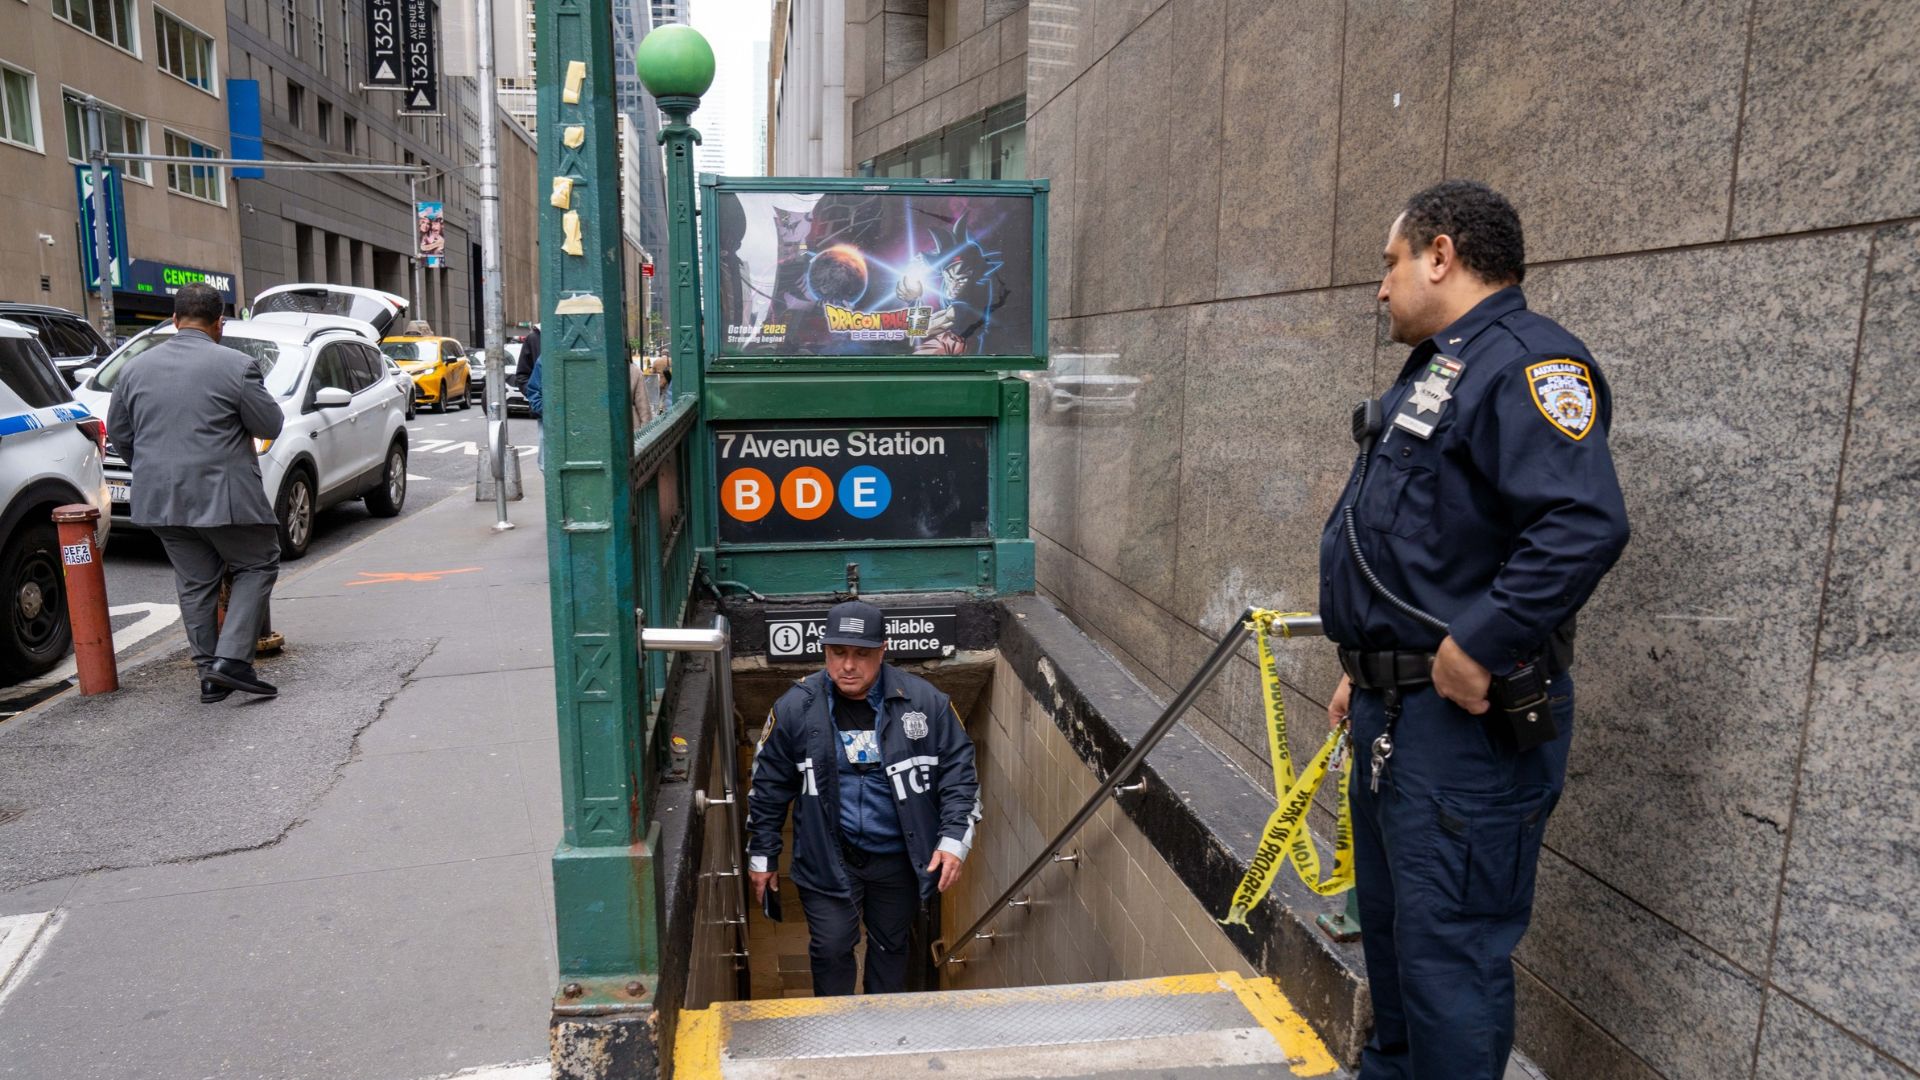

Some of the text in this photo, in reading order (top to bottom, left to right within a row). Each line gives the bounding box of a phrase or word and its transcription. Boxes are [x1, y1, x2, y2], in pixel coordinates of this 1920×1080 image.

[409, 4, 417, 40] AVENUE
[374, 8, 394, 57] 1325
[418, 23, 426, 39] THE
[410, 42, 428, 86] 1325
[825, 304, 880, 331] DRAGON
[763, 324, 787, 335] 2026
[852, 331, 904, 340] BEERUS
[761, 335, 786, 344] begins!
[1533, 364, 1582, 377] AUXILIARY
[718, 431, 945, 459] 7 Avenue Station
[108, 486, 126, 499] 712
[735, 476, 877, 511] B D E
[64, 545, 88, 556] DEF2
[884, 618, 935, 635] ailable
[886, 638, 940, 651] trance
